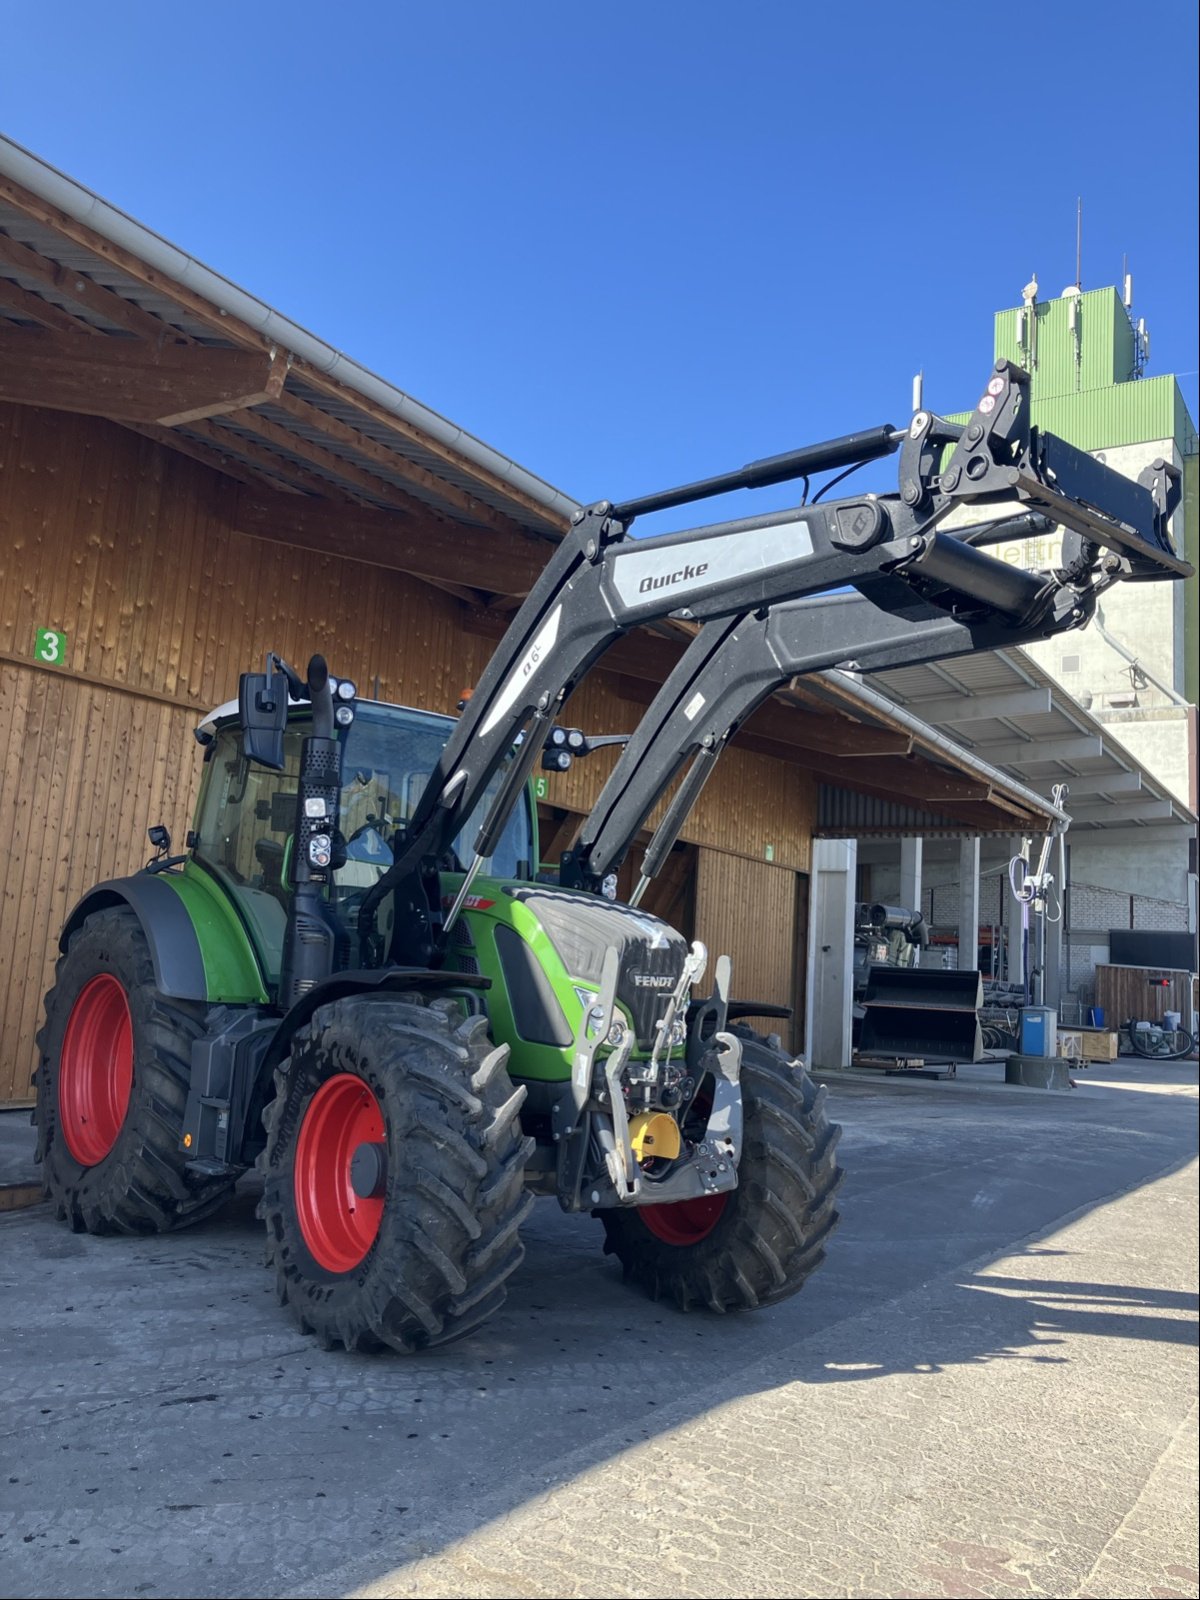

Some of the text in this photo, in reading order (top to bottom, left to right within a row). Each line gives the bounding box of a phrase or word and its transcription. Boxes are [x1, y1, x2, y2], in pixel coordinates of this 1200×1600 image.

[639, 563, 708, 593] Quicke
[41, 632, 59, 661] 3
[537, 778, 545, 797] 5
[634, 975, 675, 987] FENDT
